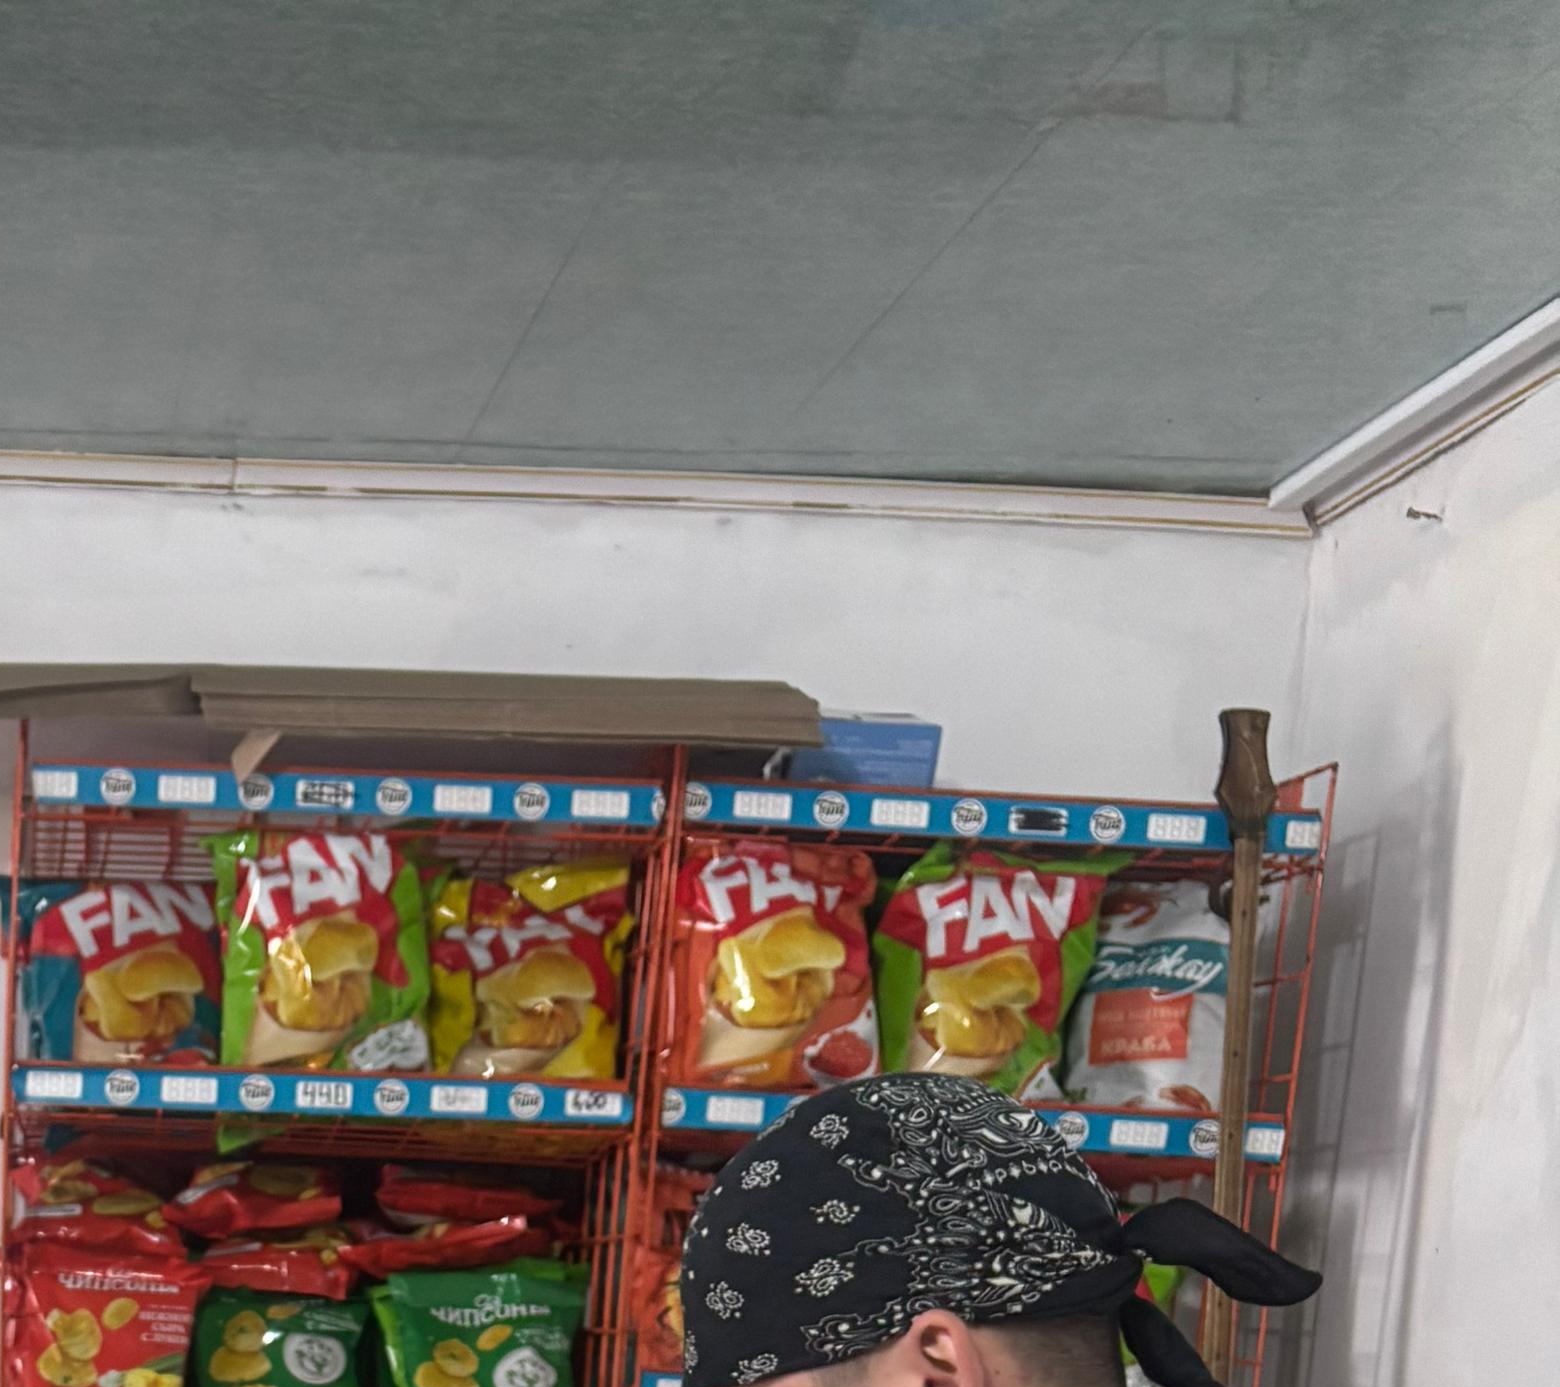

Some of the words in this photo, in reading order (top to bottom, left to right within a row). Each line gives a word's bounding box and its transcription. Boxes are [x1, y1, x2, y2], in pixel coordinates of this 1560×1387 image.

[59, 883, 216, 959] FAN
[239, 833, 392, 929] FAN
[916, 870, 1075, 958] FAN
